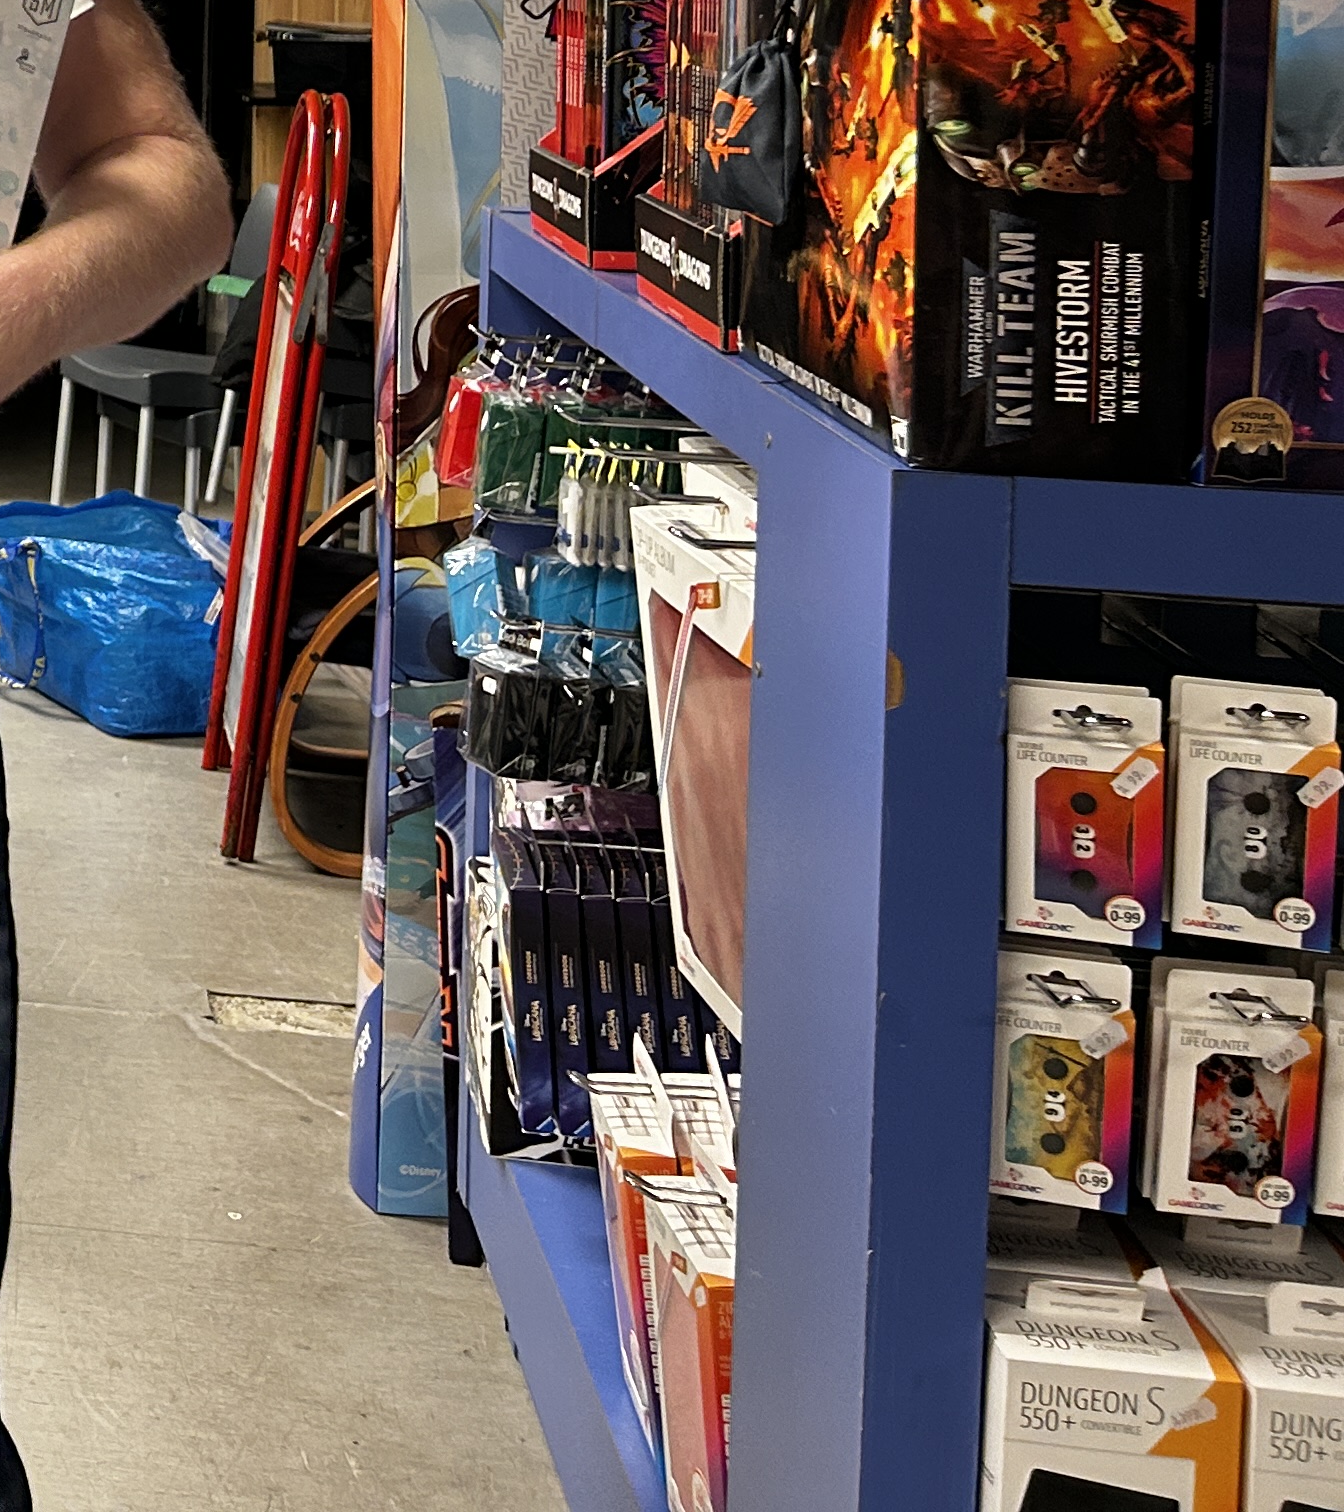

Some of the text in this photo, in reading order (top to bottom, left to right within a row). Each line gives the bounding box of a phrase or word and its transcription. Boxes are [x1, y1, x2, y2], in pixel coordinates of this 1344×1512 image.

[967, 275, 986, 379] WARHAMMER
[995, 231, 1036, 426] KILL TEAM
[1054, 259, 1091, 403] HIVESTORM
[1098, 240, 1121, 424] TACTICAL SKIRMISH COMBAT
[1121, 252, 1144, 414] IN THE 41ST MILLENNIUM
[1016, 749, 1089, 767] LIFE COUNTER
[1189, 747, 1263, 766] LIFE COUNTER
[1111, 910, 1142, 925] 0-99
[1278, 911, 1311, 926] 0-99
[1013, 1017, 1063, 1034] COUNTER
[1180, 1035, 1251, 1052] LIFE COUNTER
[1078, 1175, 1109, 1188] 0-99
[1261, 1189, 1291, 1203] 0-99
[1175, 1249, 1303, 1277] DUNGEON
[1182, 1263, 1242, 1281] 550+
[1015, 1319, 1181, 1352] DUNGEON S
[1024, 1334, 1088, 1351] 550+
[1270, 1359, 1338, 1380] 550+
[1020, 1380, 1139, 1417] DUNGEON
[1145, 1386, 1166, 1427] S
[1019, 1406, 1076, 1432] 550+
[1269, 1436, 1330, 1464] 550+
